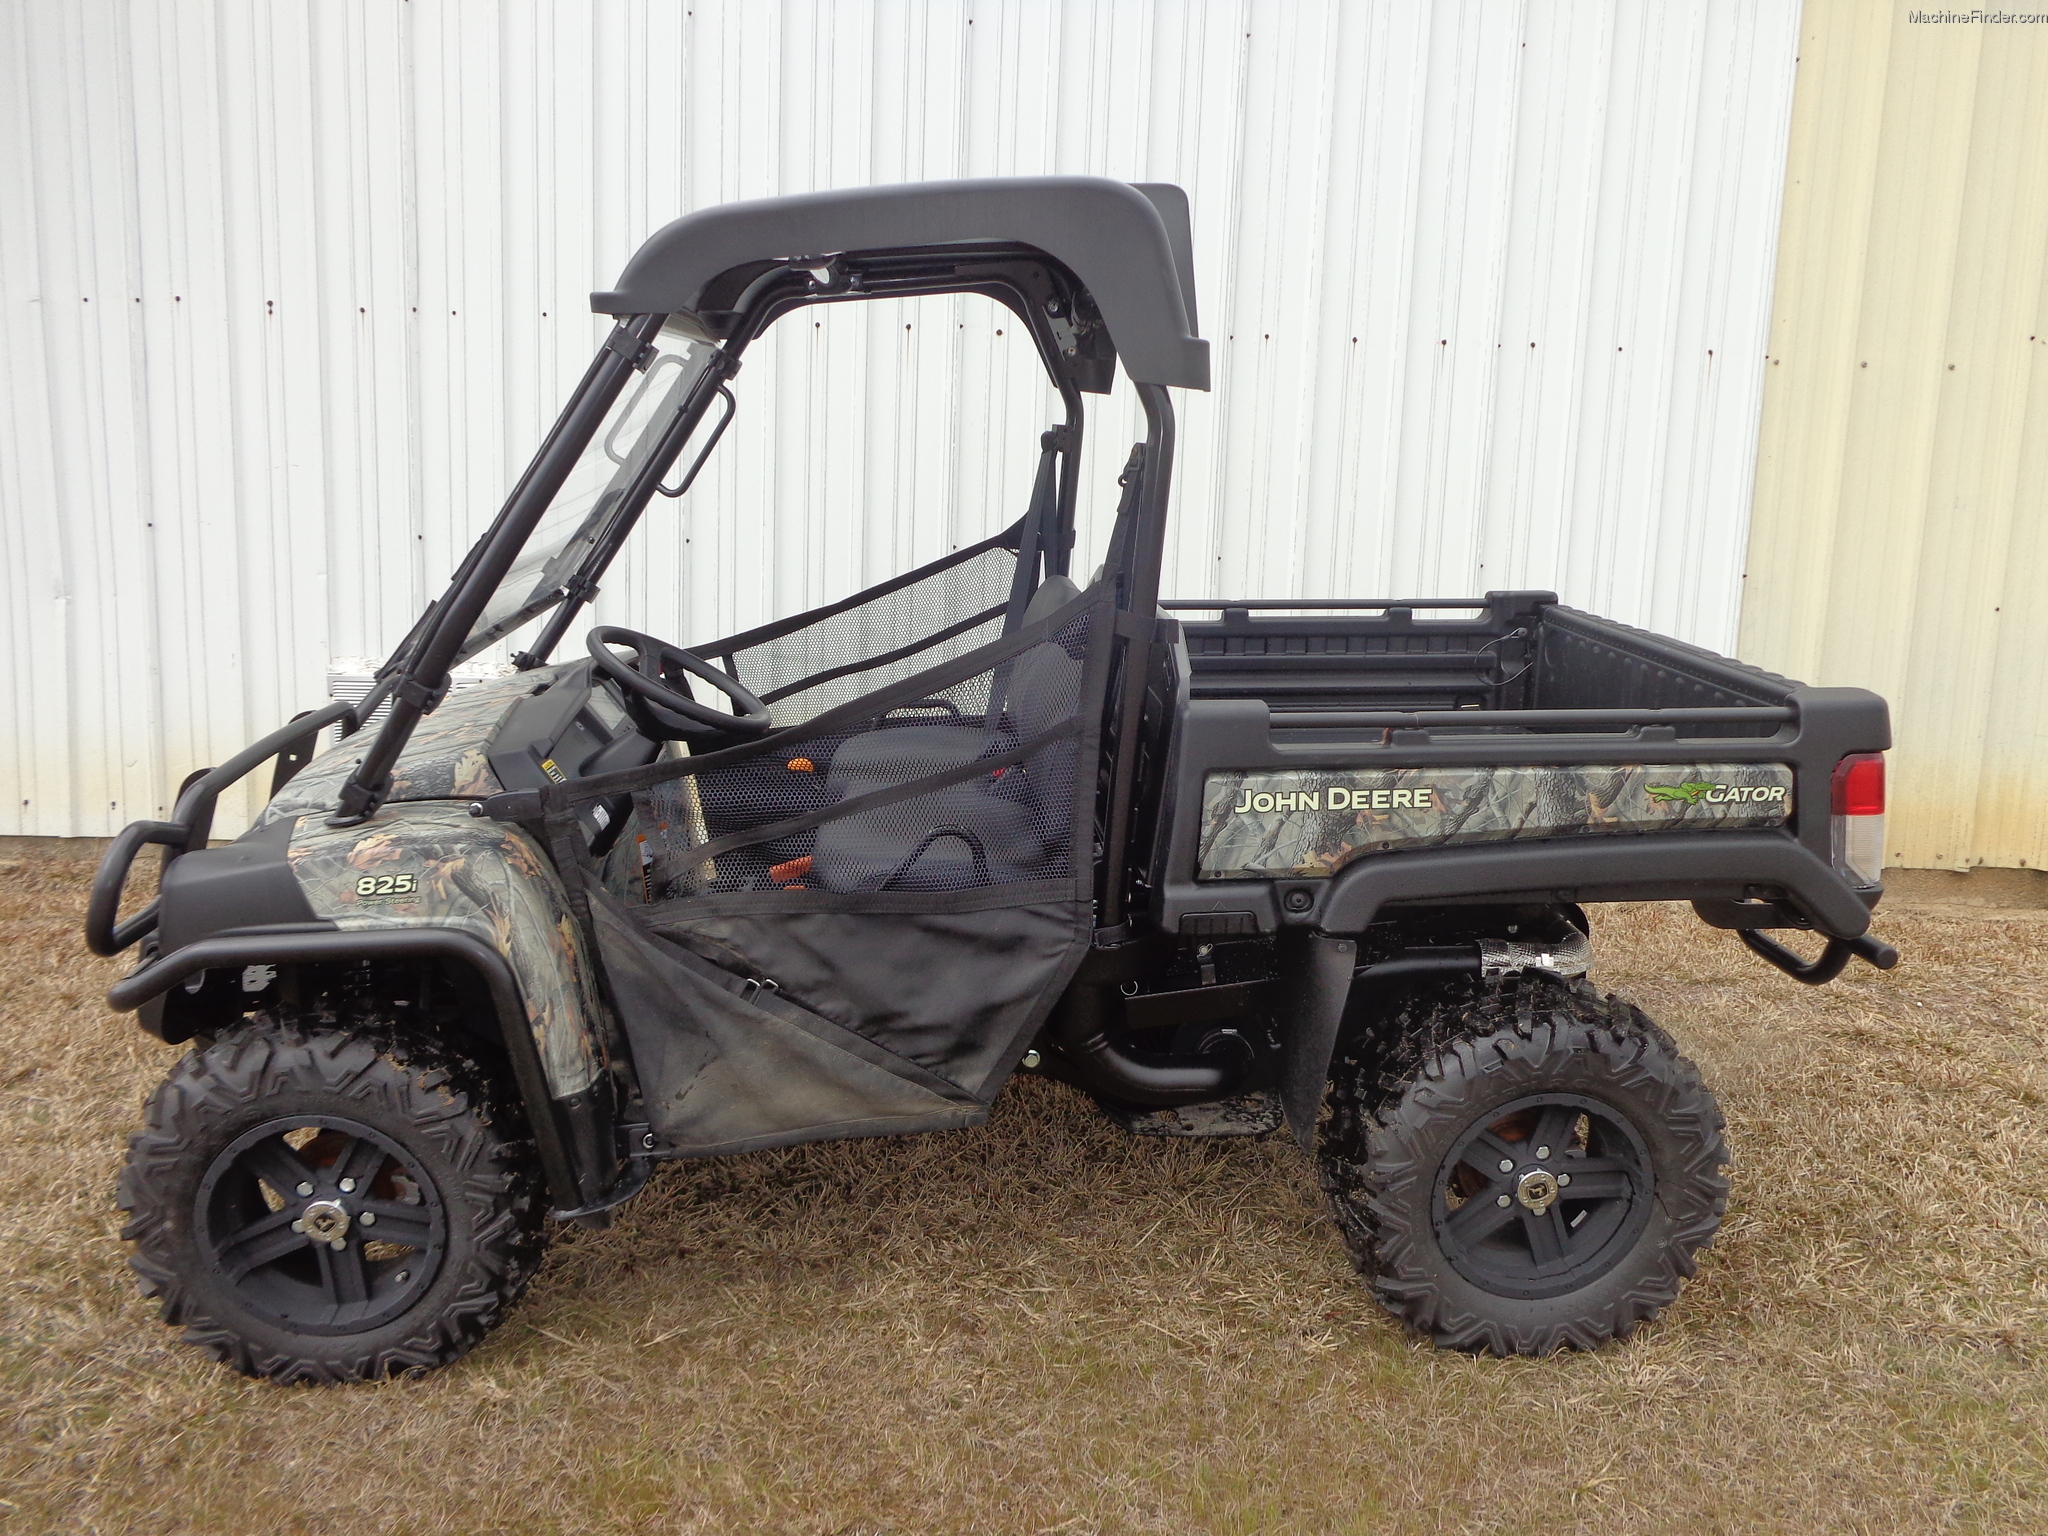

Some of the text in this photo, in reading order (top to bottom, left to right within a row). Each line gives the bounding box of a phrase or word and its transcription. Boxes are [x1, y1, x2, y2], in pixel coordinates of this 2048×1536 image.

[1234, 787, 1433, 814] JOHN DEERE
[1705, 784, 1786, 804] GATOR
[356, 874, 418, 896] 825i
[356, 896, 421, 907] Power Steering
